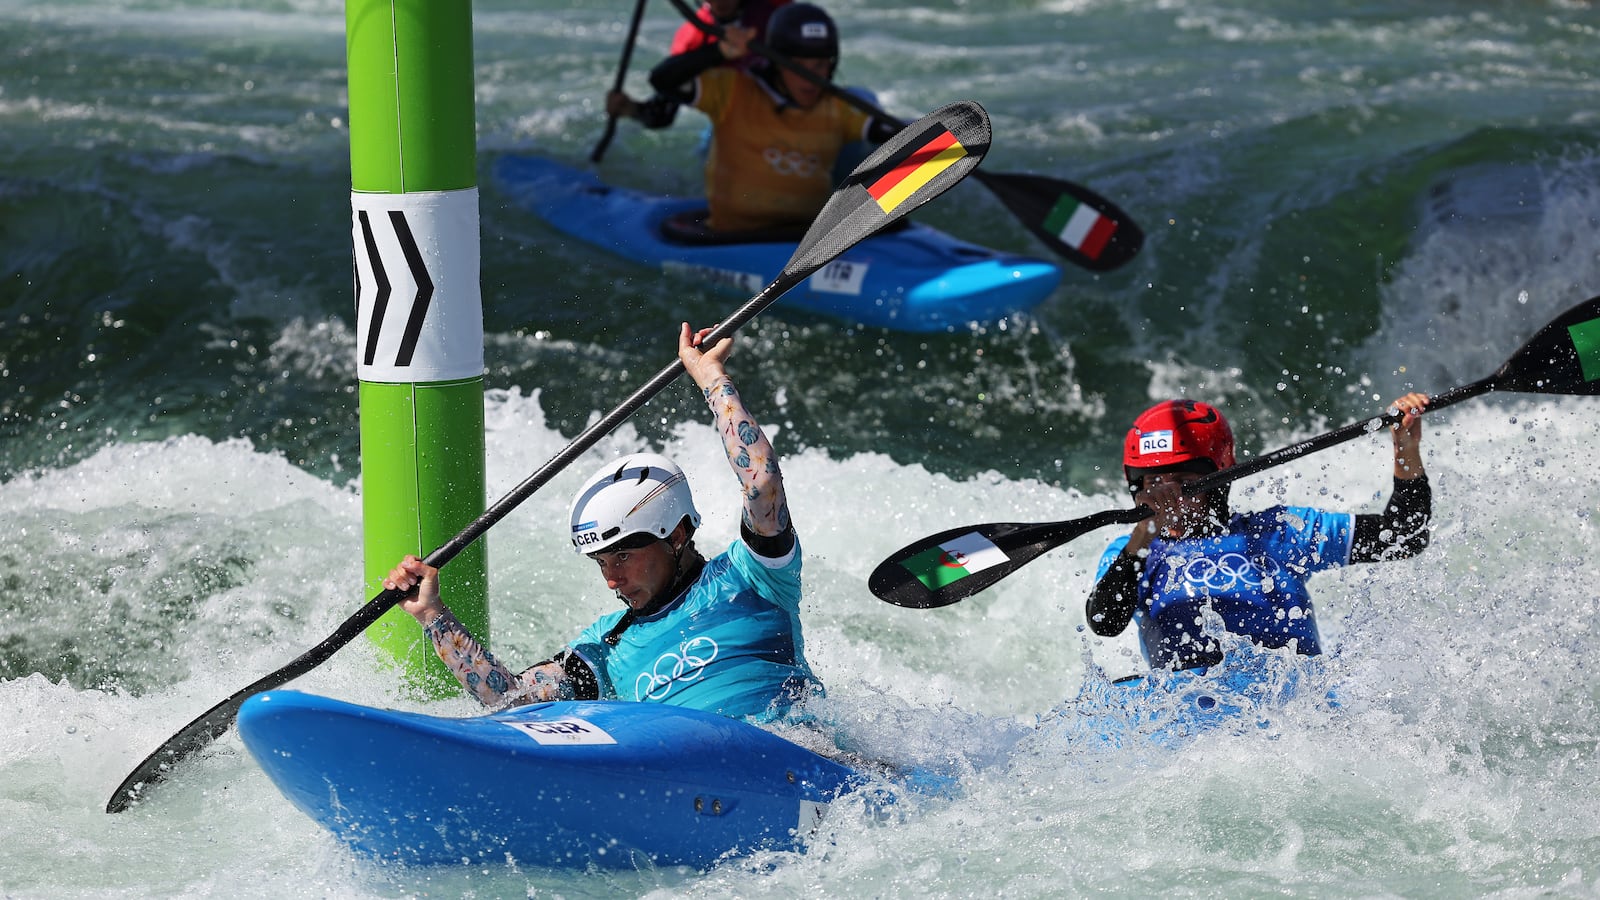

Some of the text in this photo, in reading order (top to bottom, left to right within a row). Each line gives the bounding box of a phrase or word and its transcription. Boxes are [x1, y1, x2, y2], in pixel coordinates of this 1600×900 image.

[1144, 438, 1168, 450] ALG
[577, 532, 600, 546] GER
[523, 722, 591, 734] GER
